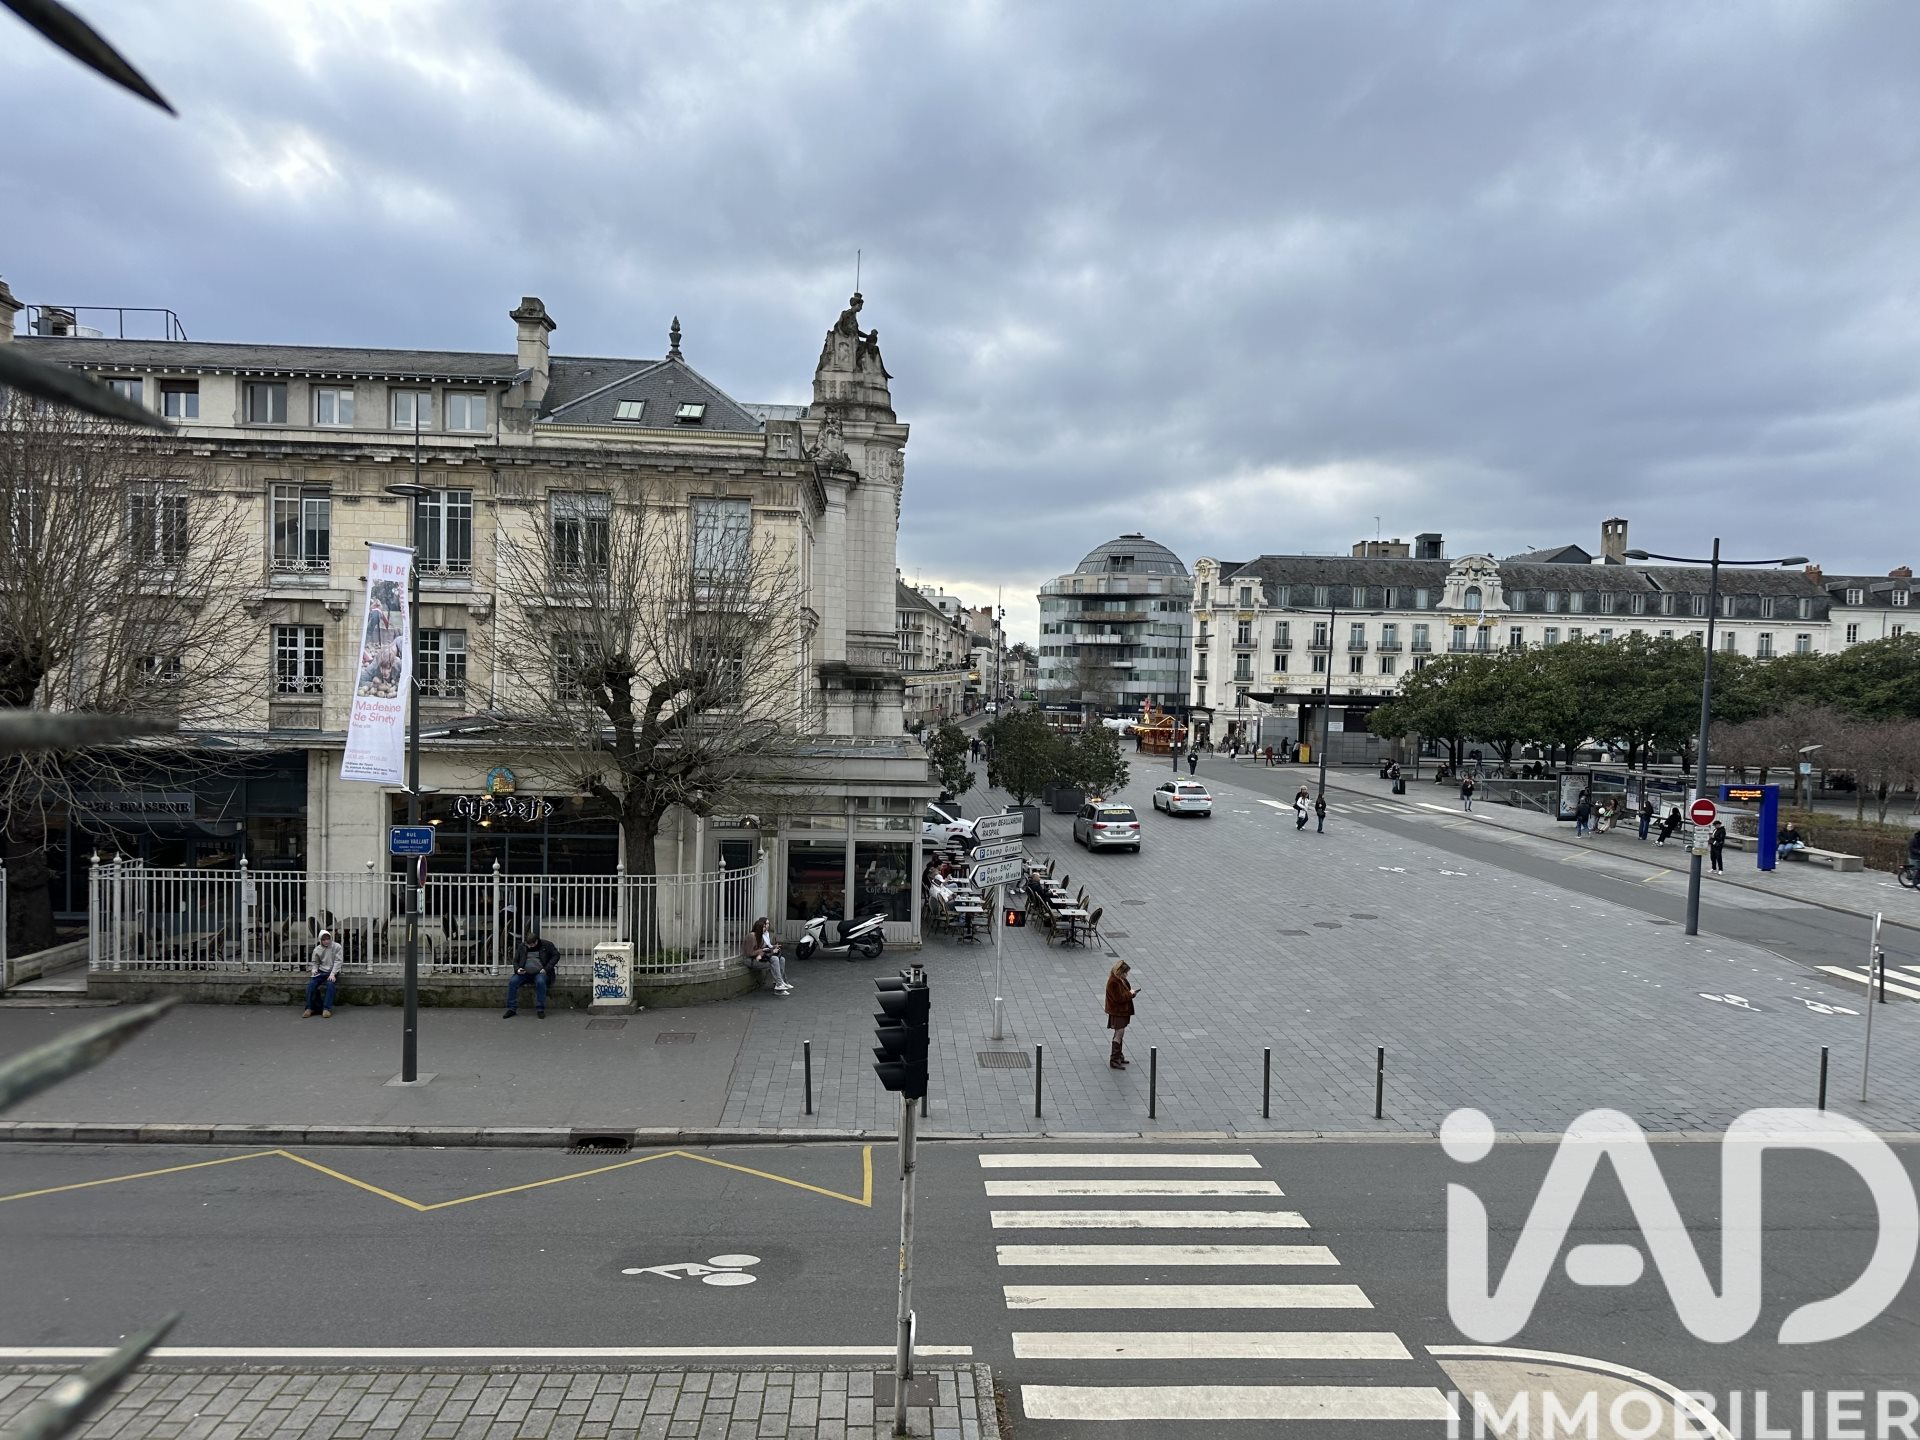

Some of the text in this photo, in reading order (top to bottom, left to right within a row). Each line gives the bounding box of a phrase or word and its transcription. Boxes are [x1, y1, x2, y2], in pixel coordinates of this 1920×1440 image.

[354, 712, 366, 722] de
[986, 848, 1002, 857] Champ
[1000, 862, 1012, 872] SNCF
